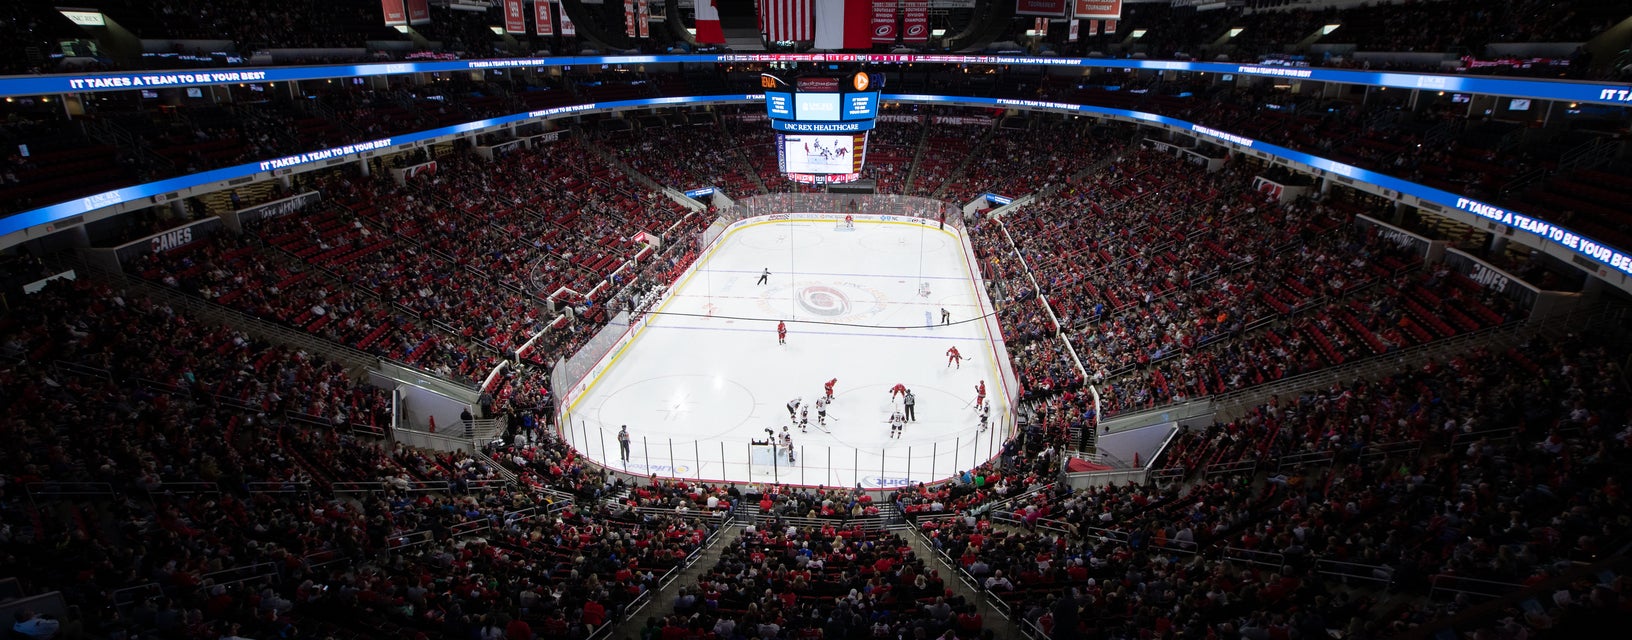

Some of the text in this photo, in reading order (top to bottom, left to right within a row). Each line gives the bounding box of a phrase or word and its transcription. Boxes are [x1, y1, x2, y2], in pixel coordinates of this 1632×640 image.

[70, 72, 266, 88] IT TAKES A TEAM TO BE YOUR BEST
[1600, 89, 1617, 99] IT
[260, 139, 392, 170] IT TAKES A TEAM TO BE YOUR BEST
[152, 227, 192, 252] CANES
[1456, 198, 1469, 209] IT
[1469, 201, 1503, 220] TAKES
[1502, 213, 1512, 224] A
[1514, 215, 1549, 235] TEAM
[1548, 226, 1564, 240] TO
[1562, 232, 1580, 248] BE
[1579, 239, 1612, 262] YOUR
[1469, 263, 1508, 293] CANES
